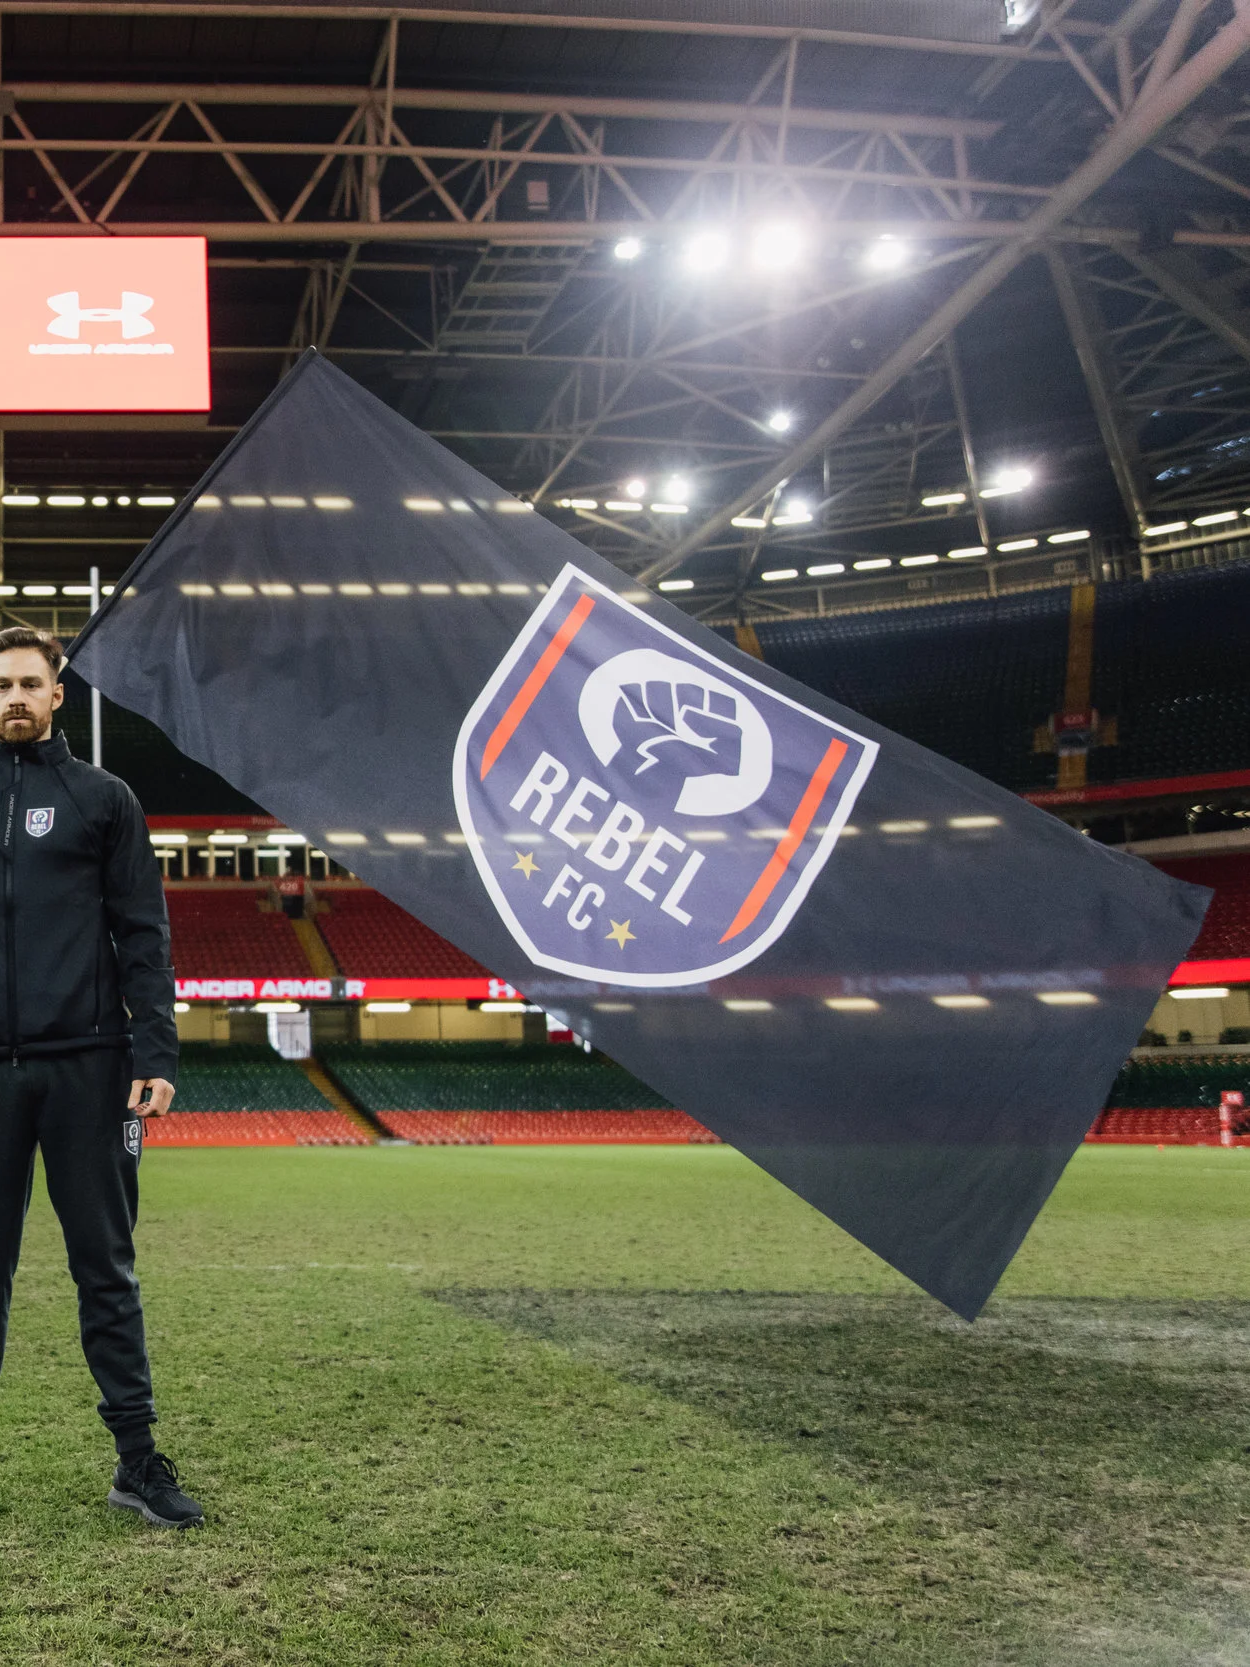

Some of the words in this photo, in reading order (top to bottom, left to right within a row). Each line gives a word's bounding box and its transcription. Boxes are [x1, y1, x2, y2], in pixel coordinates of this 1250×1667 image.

[509, 750, 706, 926] REBEL
[541, 863, 606, 931] FC
[260, 980, 365, 997] ARMOR
